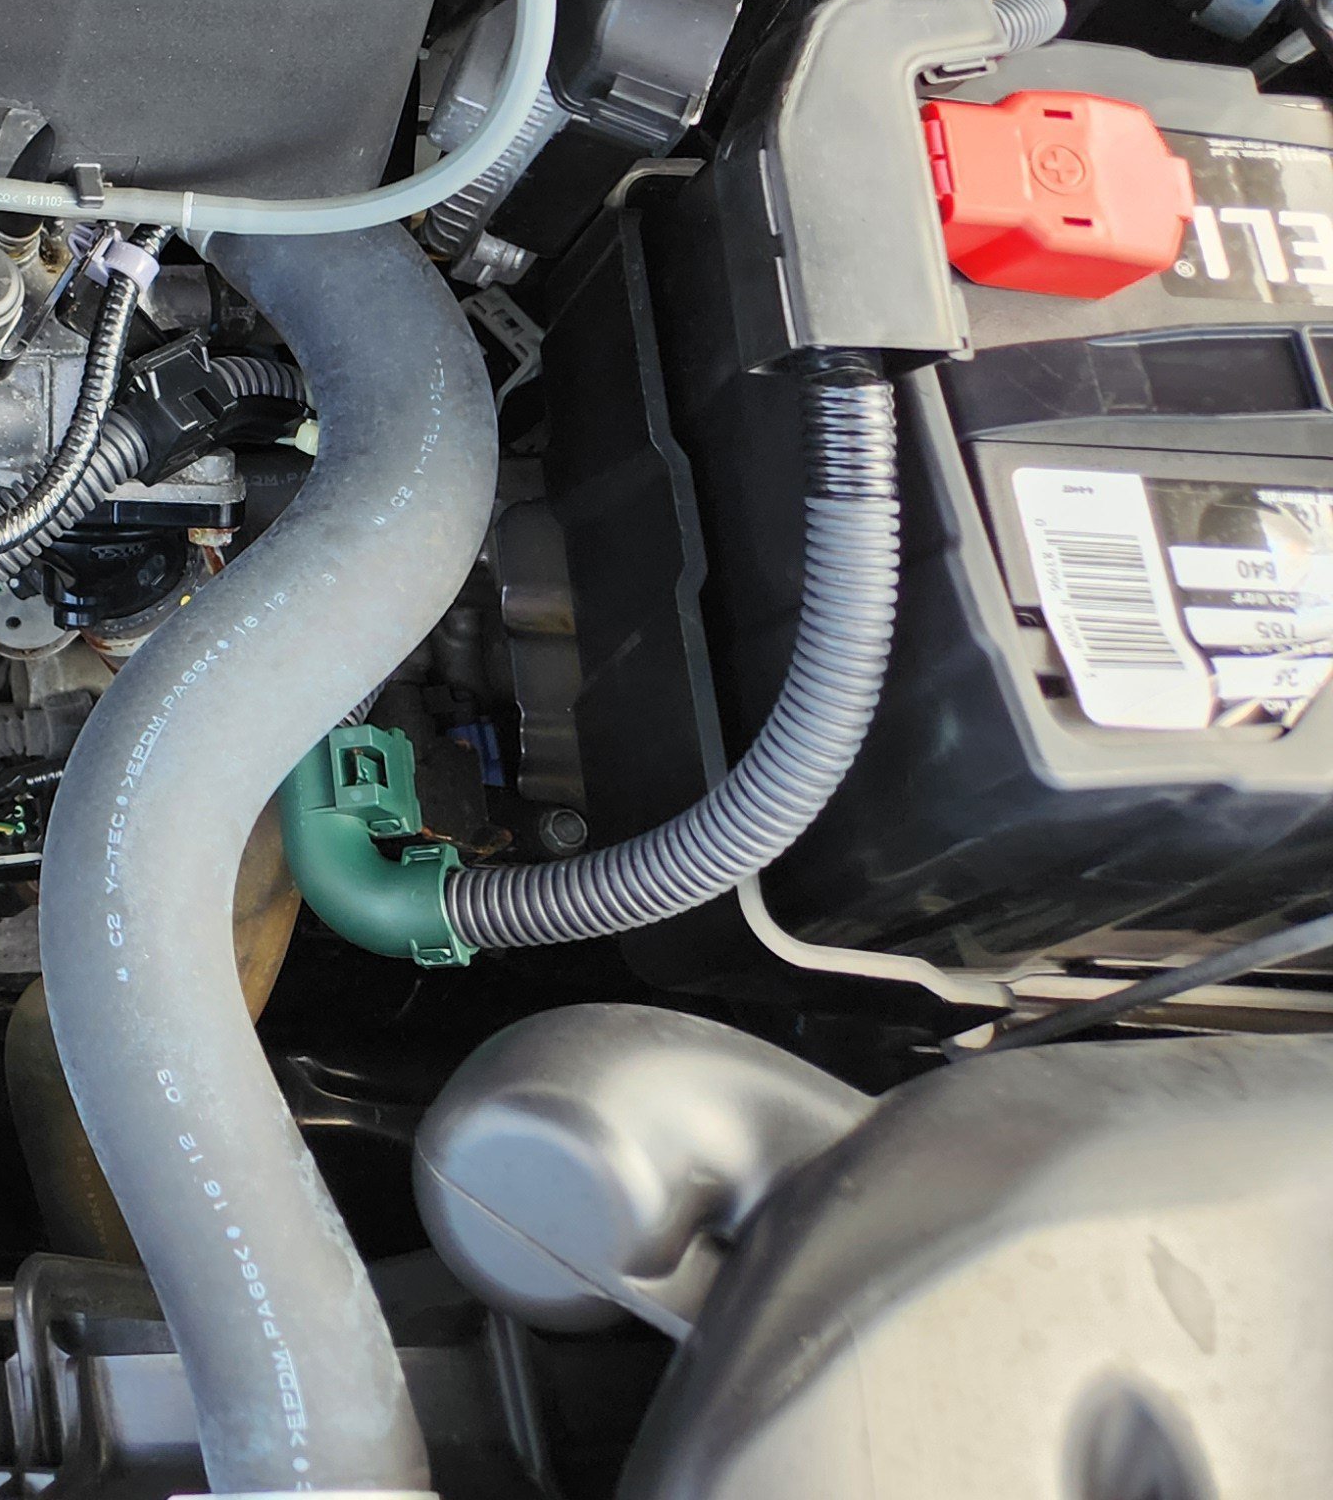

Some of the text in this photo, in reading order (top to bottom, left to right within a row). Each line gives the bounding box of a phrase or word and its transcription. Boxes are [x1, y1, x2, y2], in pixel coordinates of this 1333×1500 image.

[104, 812, 126, 896] Y-TEC
[106, 912, 124, 948] C2
[157, 1067, 182, 1104] 03
[178, 1131, 204, 1165] 12
[203, 1178, 229, 1212] 16
